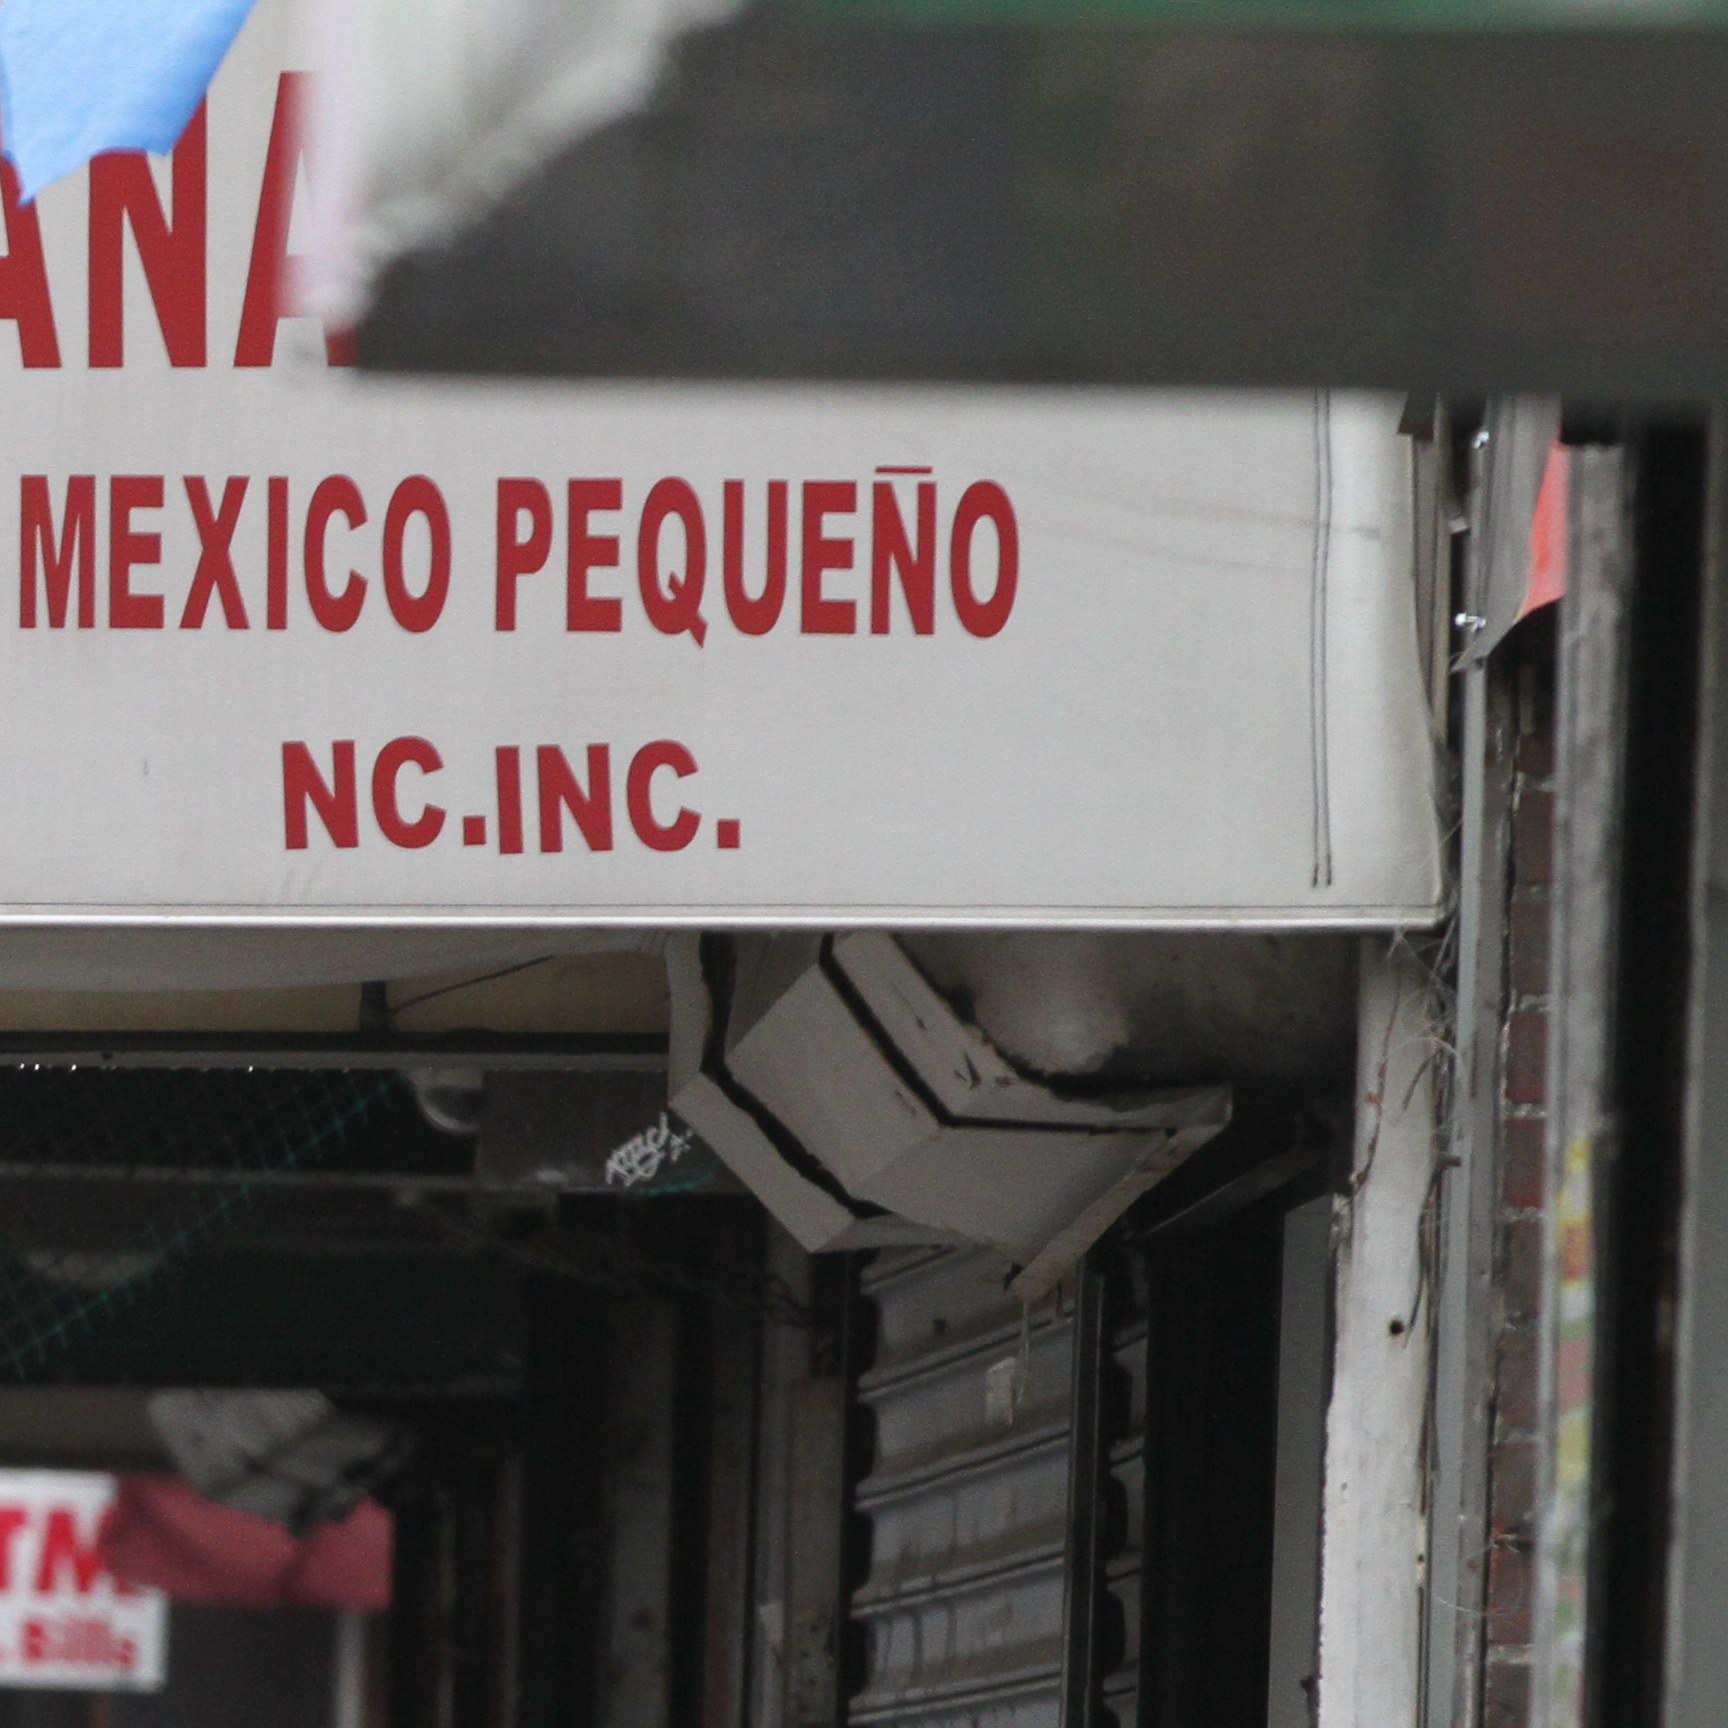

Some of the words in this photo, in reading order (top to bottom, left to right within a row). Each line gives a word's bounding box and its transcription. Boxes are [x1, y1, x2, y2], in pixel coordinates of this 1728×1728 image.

[19, 474, 452, 634] MEXICO
[494, 465, 1020, 649] PEQUEÑO
[280, 735, 743, 857] NC.INC.
